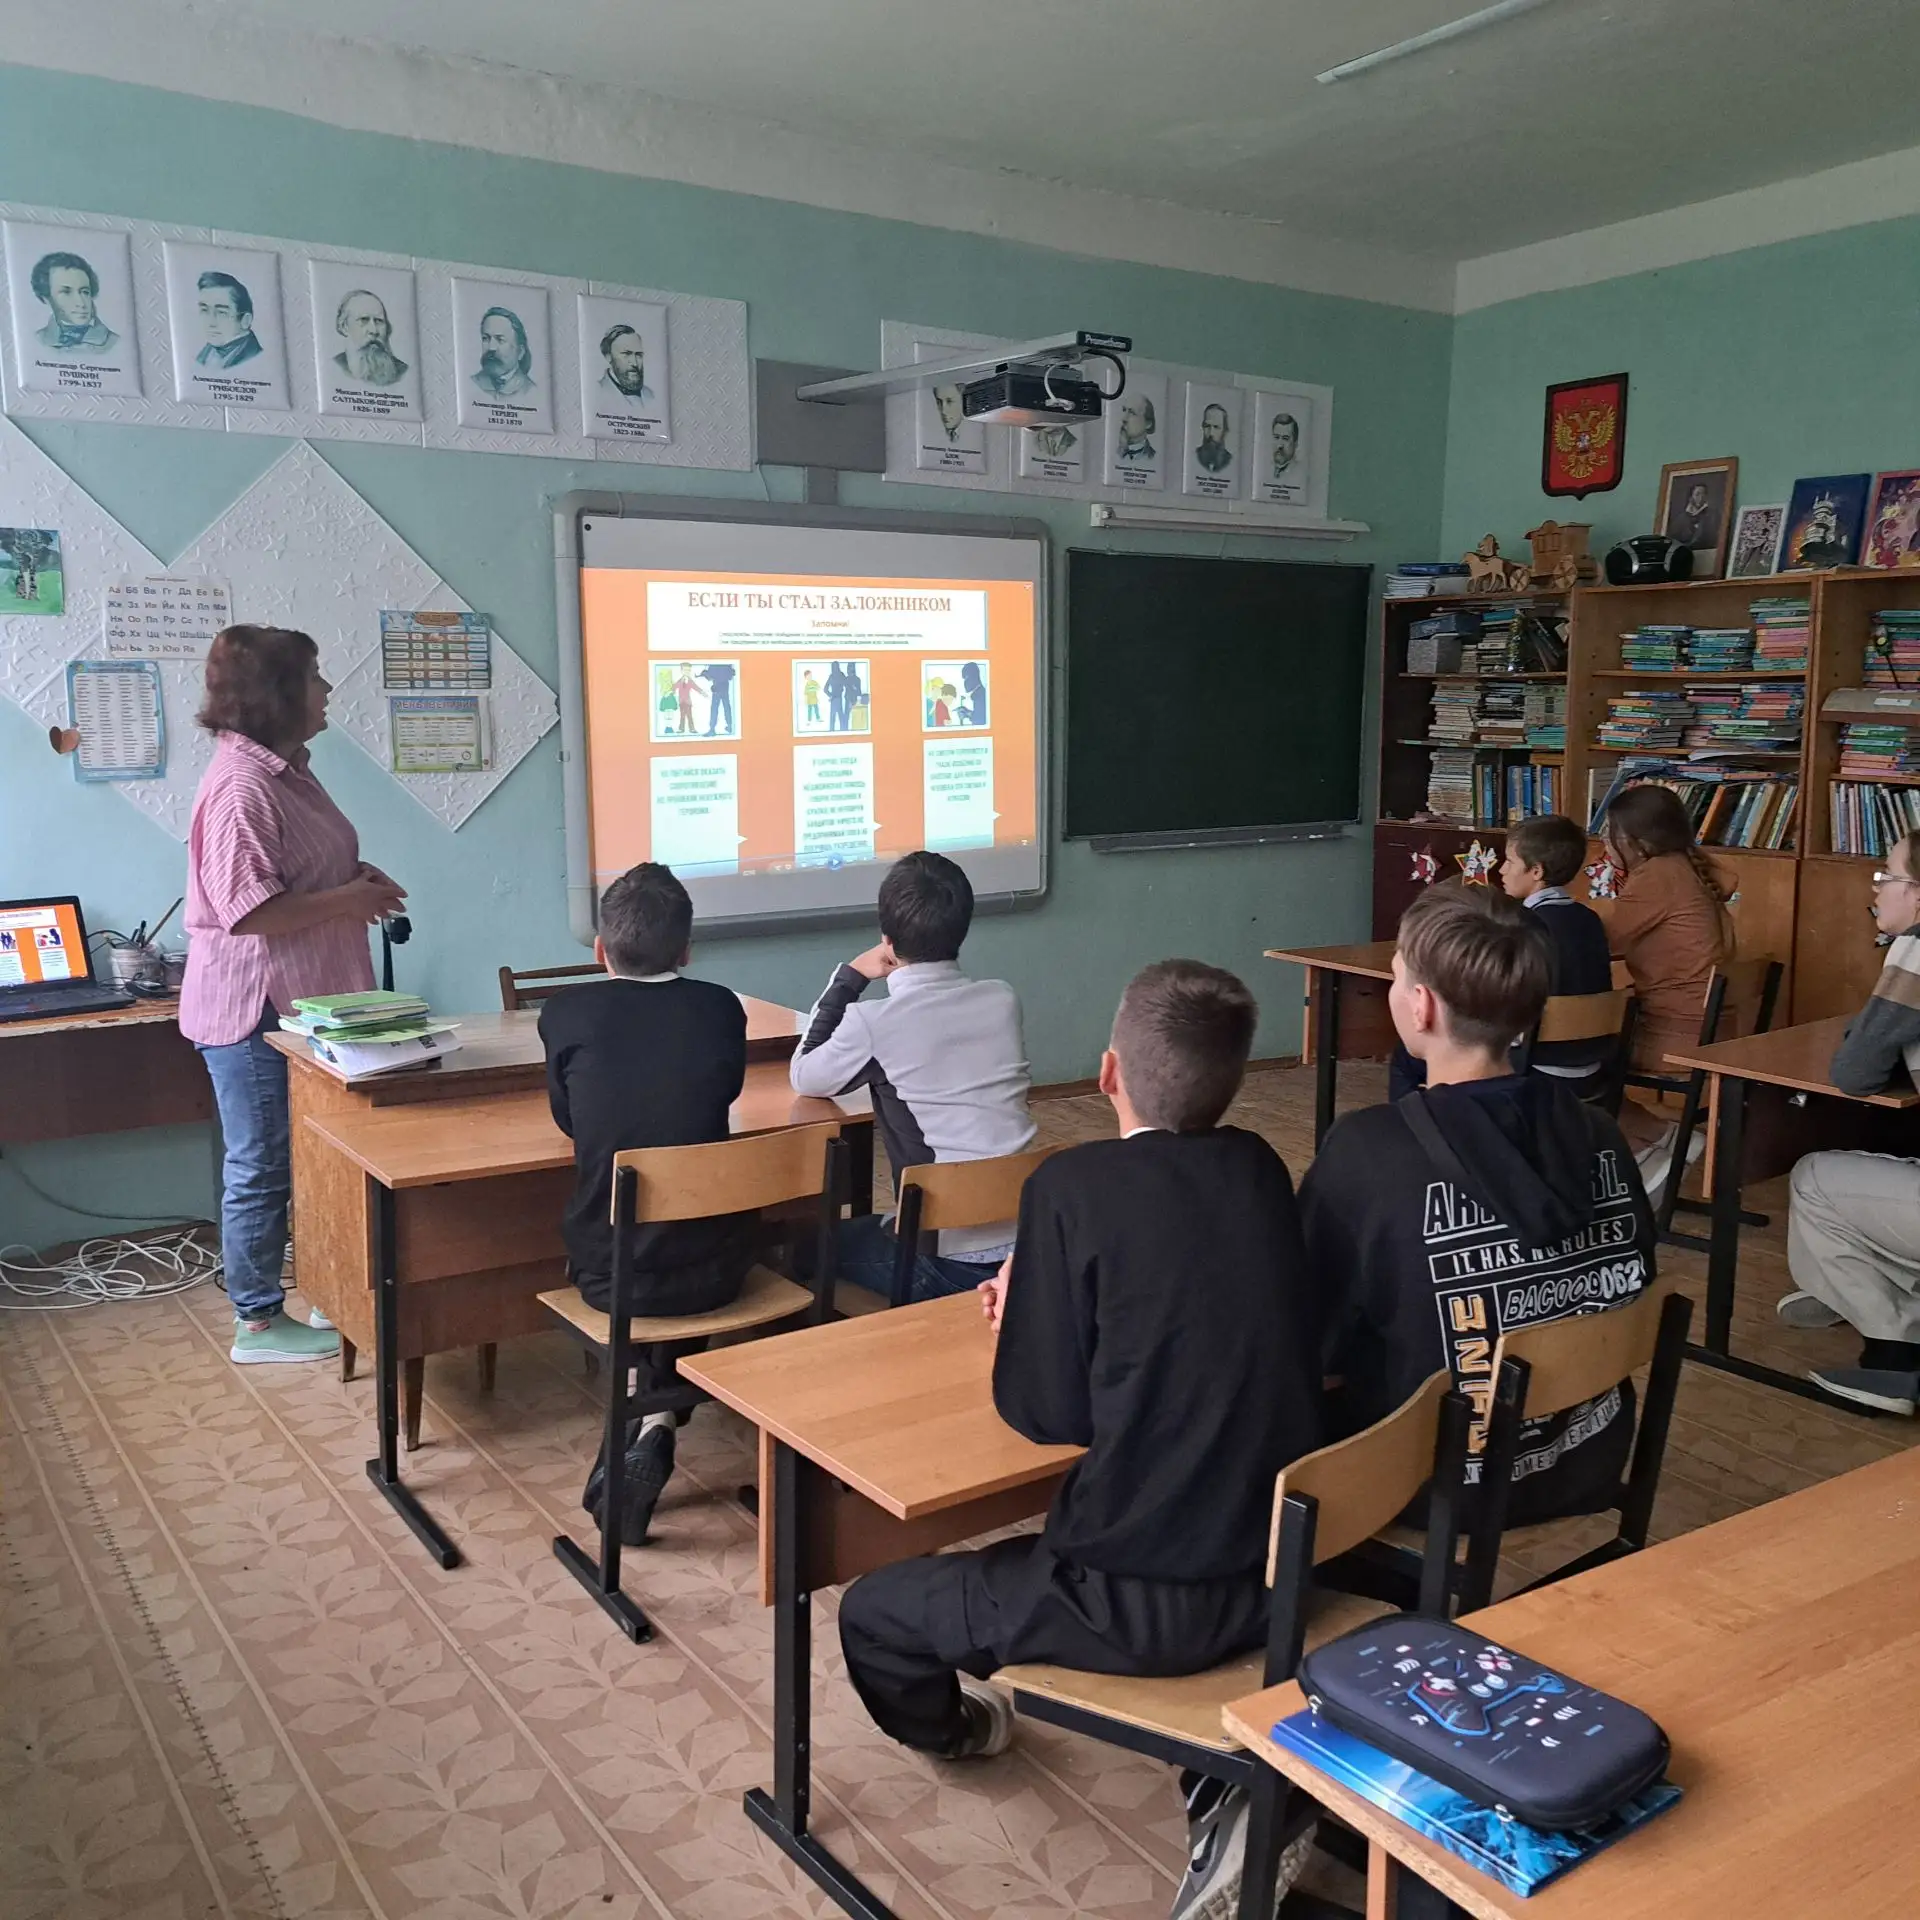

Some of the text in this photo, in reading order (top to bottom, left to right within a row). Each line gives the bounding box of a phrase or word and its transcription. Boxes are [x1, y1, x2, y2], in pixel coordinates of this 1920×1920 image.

[58, 379, 102, 388] 1799-1837
[688, 591, 951, 612] ЕСЛИ ТЫ СТАЛ ЗАЛОЖНИКОМ
[1480, 1243, 1526, 1271] HAS.
